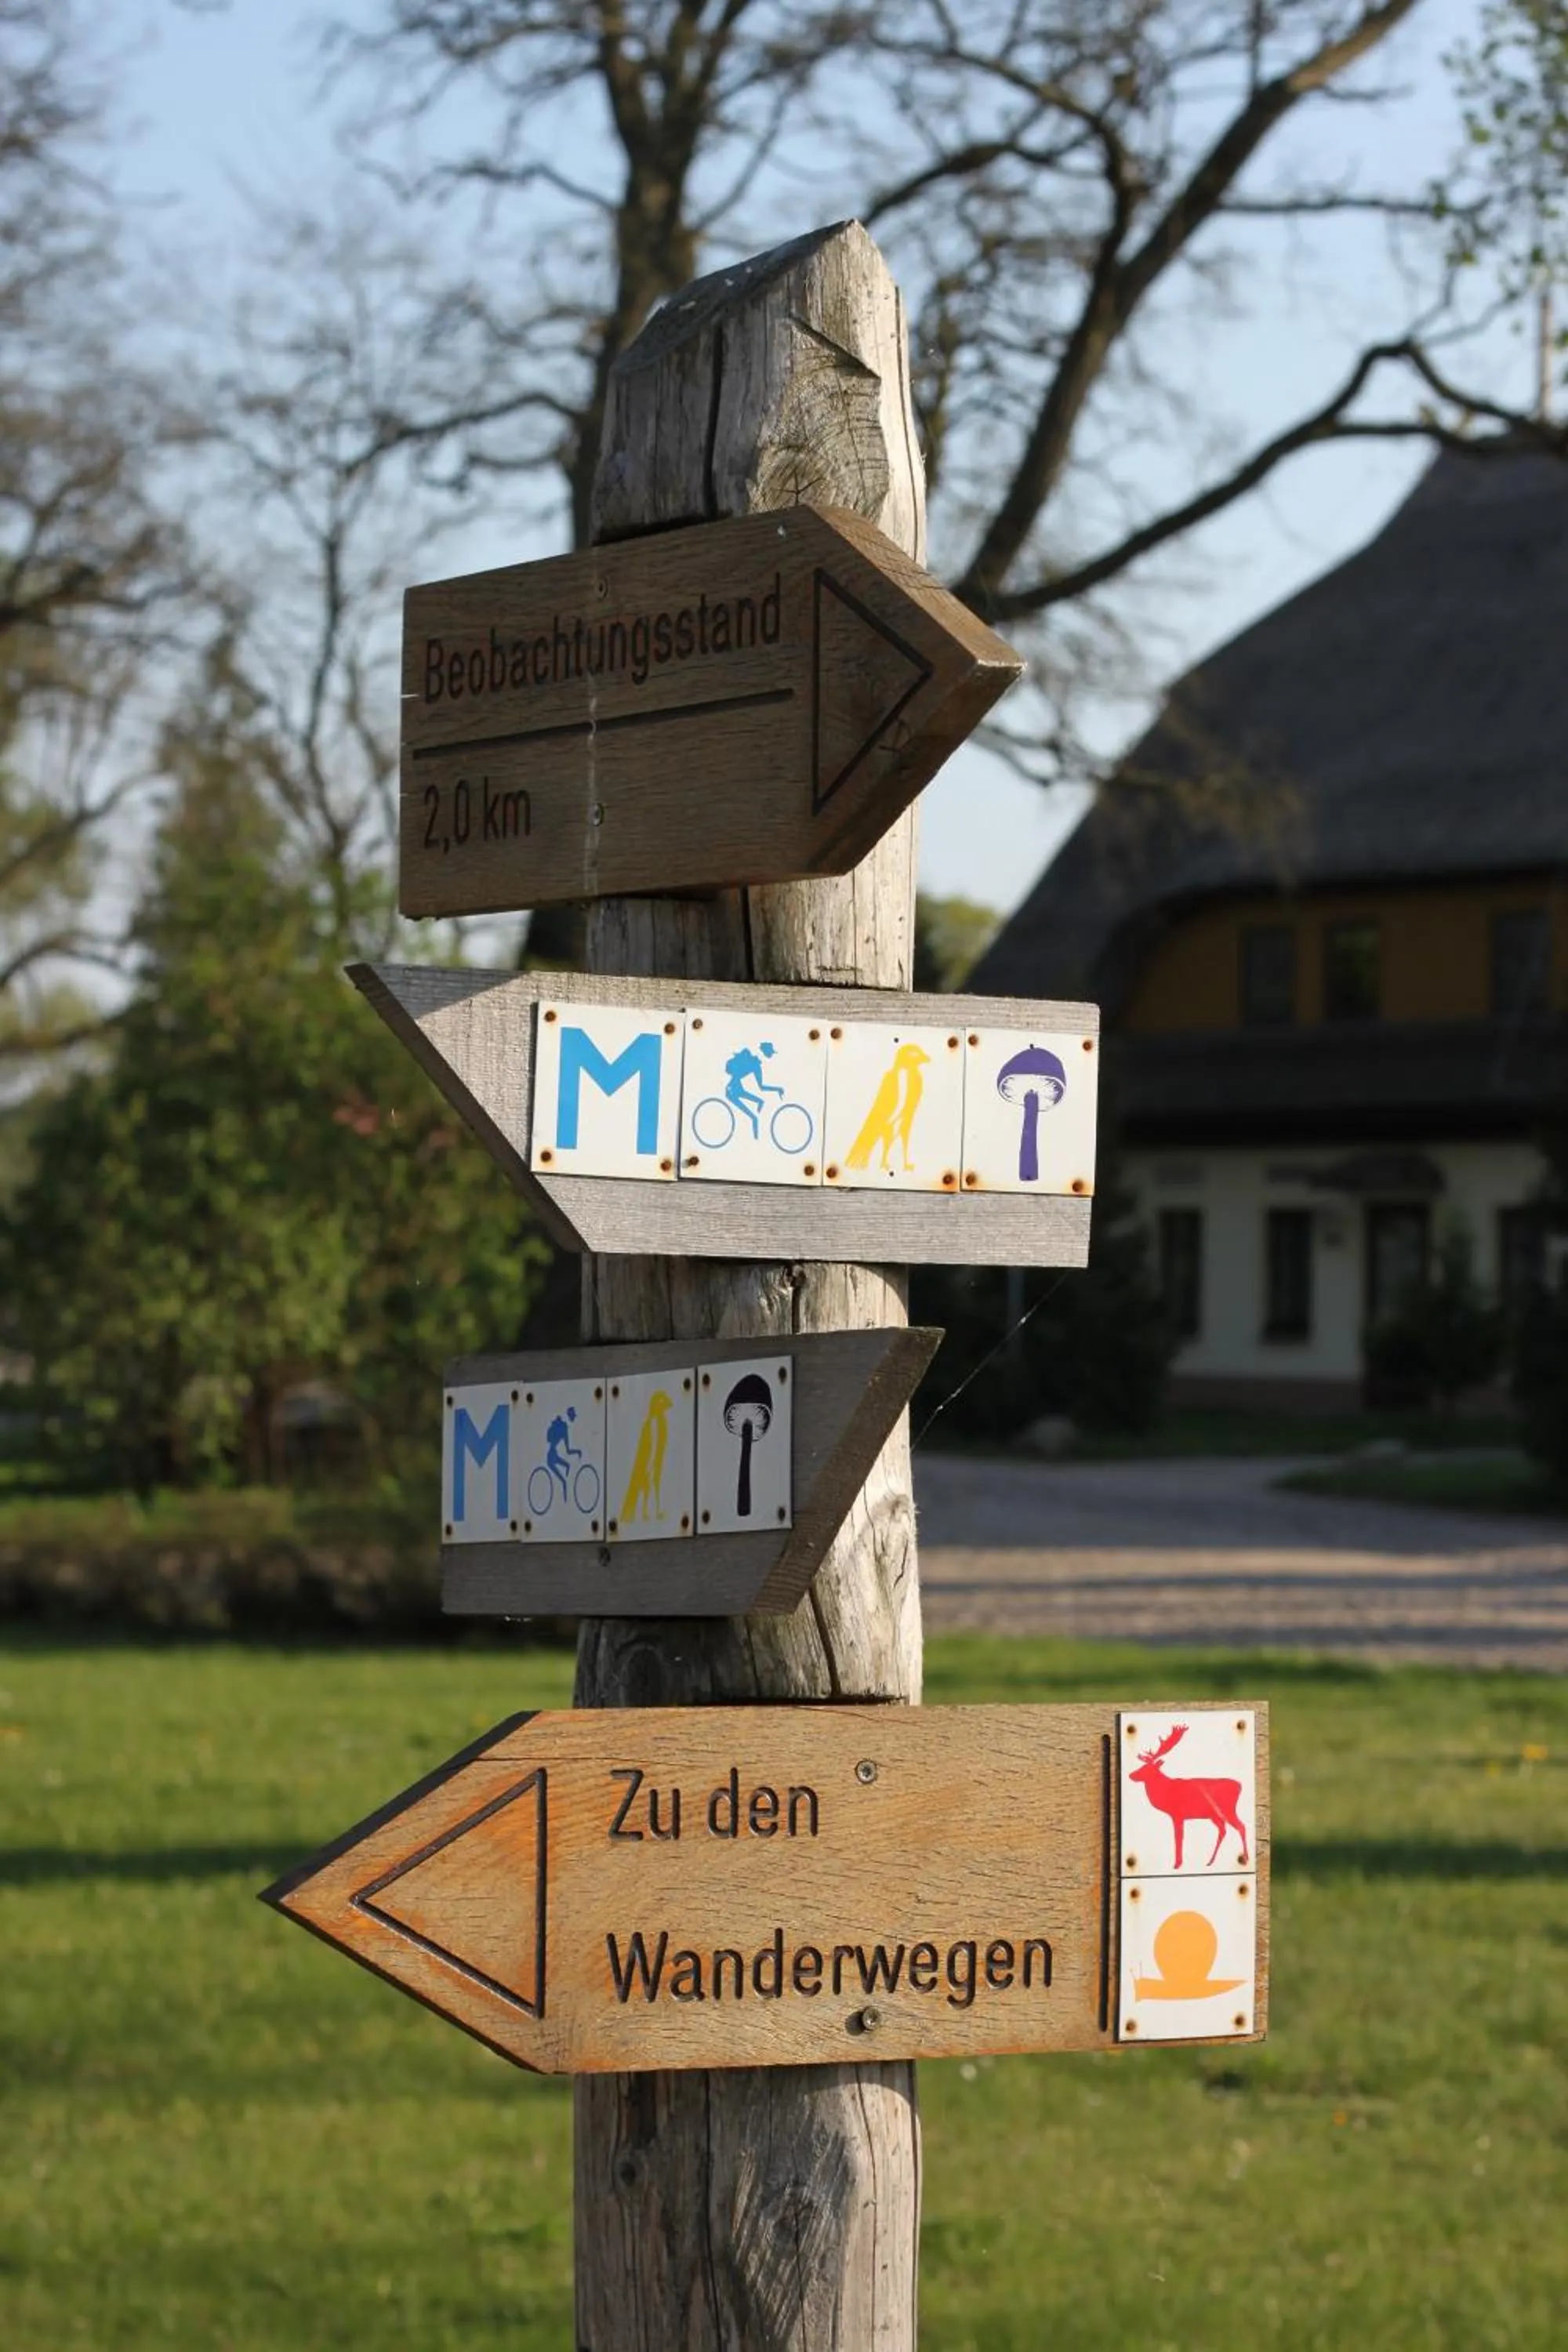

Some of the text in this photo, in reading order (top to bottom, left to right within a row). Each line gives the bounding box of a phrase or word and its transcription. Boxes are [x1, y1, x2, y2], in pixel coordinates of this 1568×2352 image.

[424, 572, 781, 703] Beobachtungsstand
[424, 776, 531, 855] 2,0 km
[556, 1026, 662, 1155] M
[452, 1404, 510, 1521] M
[608, 1766, 819, 1842] Zu den
[606, 1927, 1053, 2010] Wanderwegen
